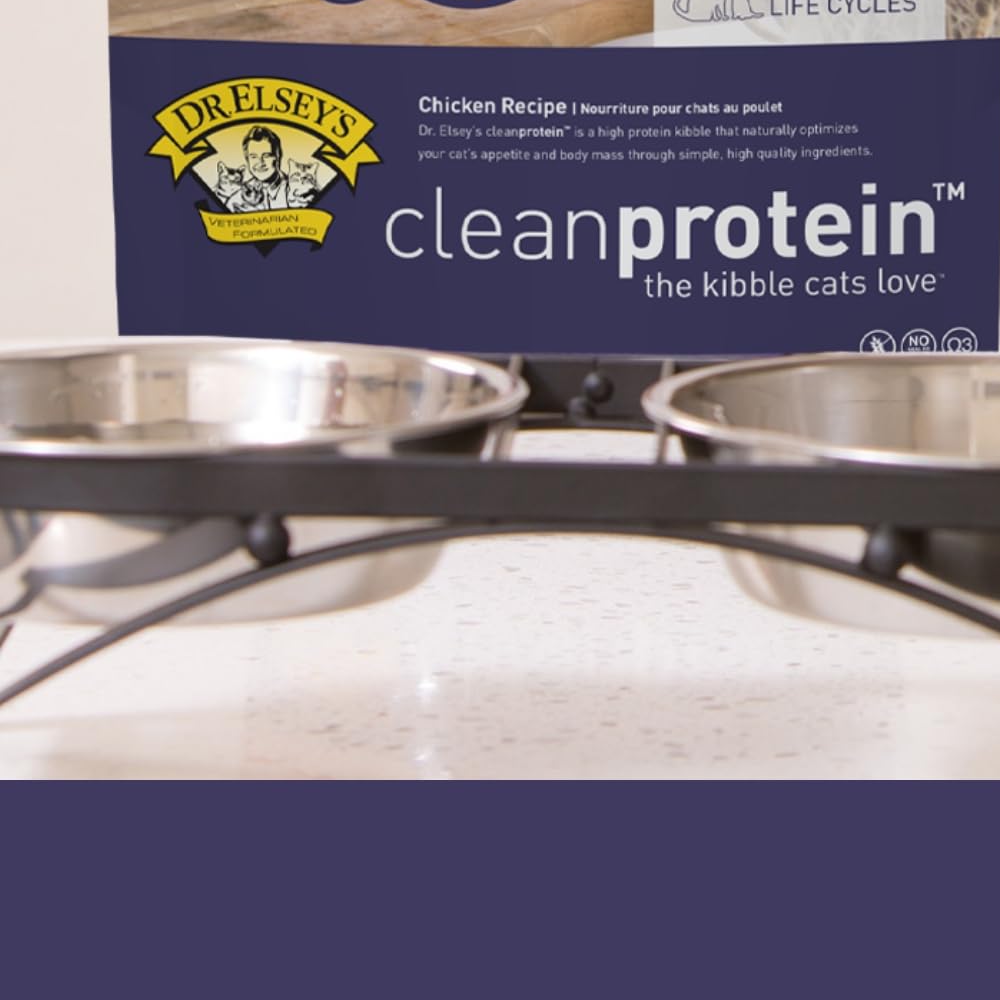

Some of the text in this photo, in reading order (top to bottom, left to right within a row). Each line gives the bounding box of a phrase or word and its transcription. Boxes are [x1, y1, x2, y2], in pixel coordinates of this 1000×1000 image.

[228, 83, 357, 139] ELSEY'S
[418, 96, 496, 114] Chicken
[501, 97, 567, 119] Recipe
[580, 103, 649, 115] Nourriture
[652, 104, 683, 117] pour
[685, 102, 720, 115] chats
[723, 104, 739, 114] au
[743, 101, 783, 116] poulet
[418, 124, 436, 137] Dr.
[439, 124, 482, 140] Elsey's
[574, 126, 584, 137] is
[588, 128, 595, 137] a
[598, 126, 625, 141] high
[628, 126, 671, 140] protein
[674, 125, 712, 137] kibble
[715, 124, 740, 137] that
[742, 123, 797, 139] naturally
[799, 122, 859, 138] optimizes
[417, 146, 873, 163] your cat's appetite and body mass through simple, high quality ingredients.
[208, 214, 300, 227] VETERINARIAN
[232, 227, 317, 240] FORMULATED
[644, 272, 692, 298] the
[703, 270, 794, 297] kibble
[805, 271, 867, 296] cats
[909, 335, 930, 347] NO
